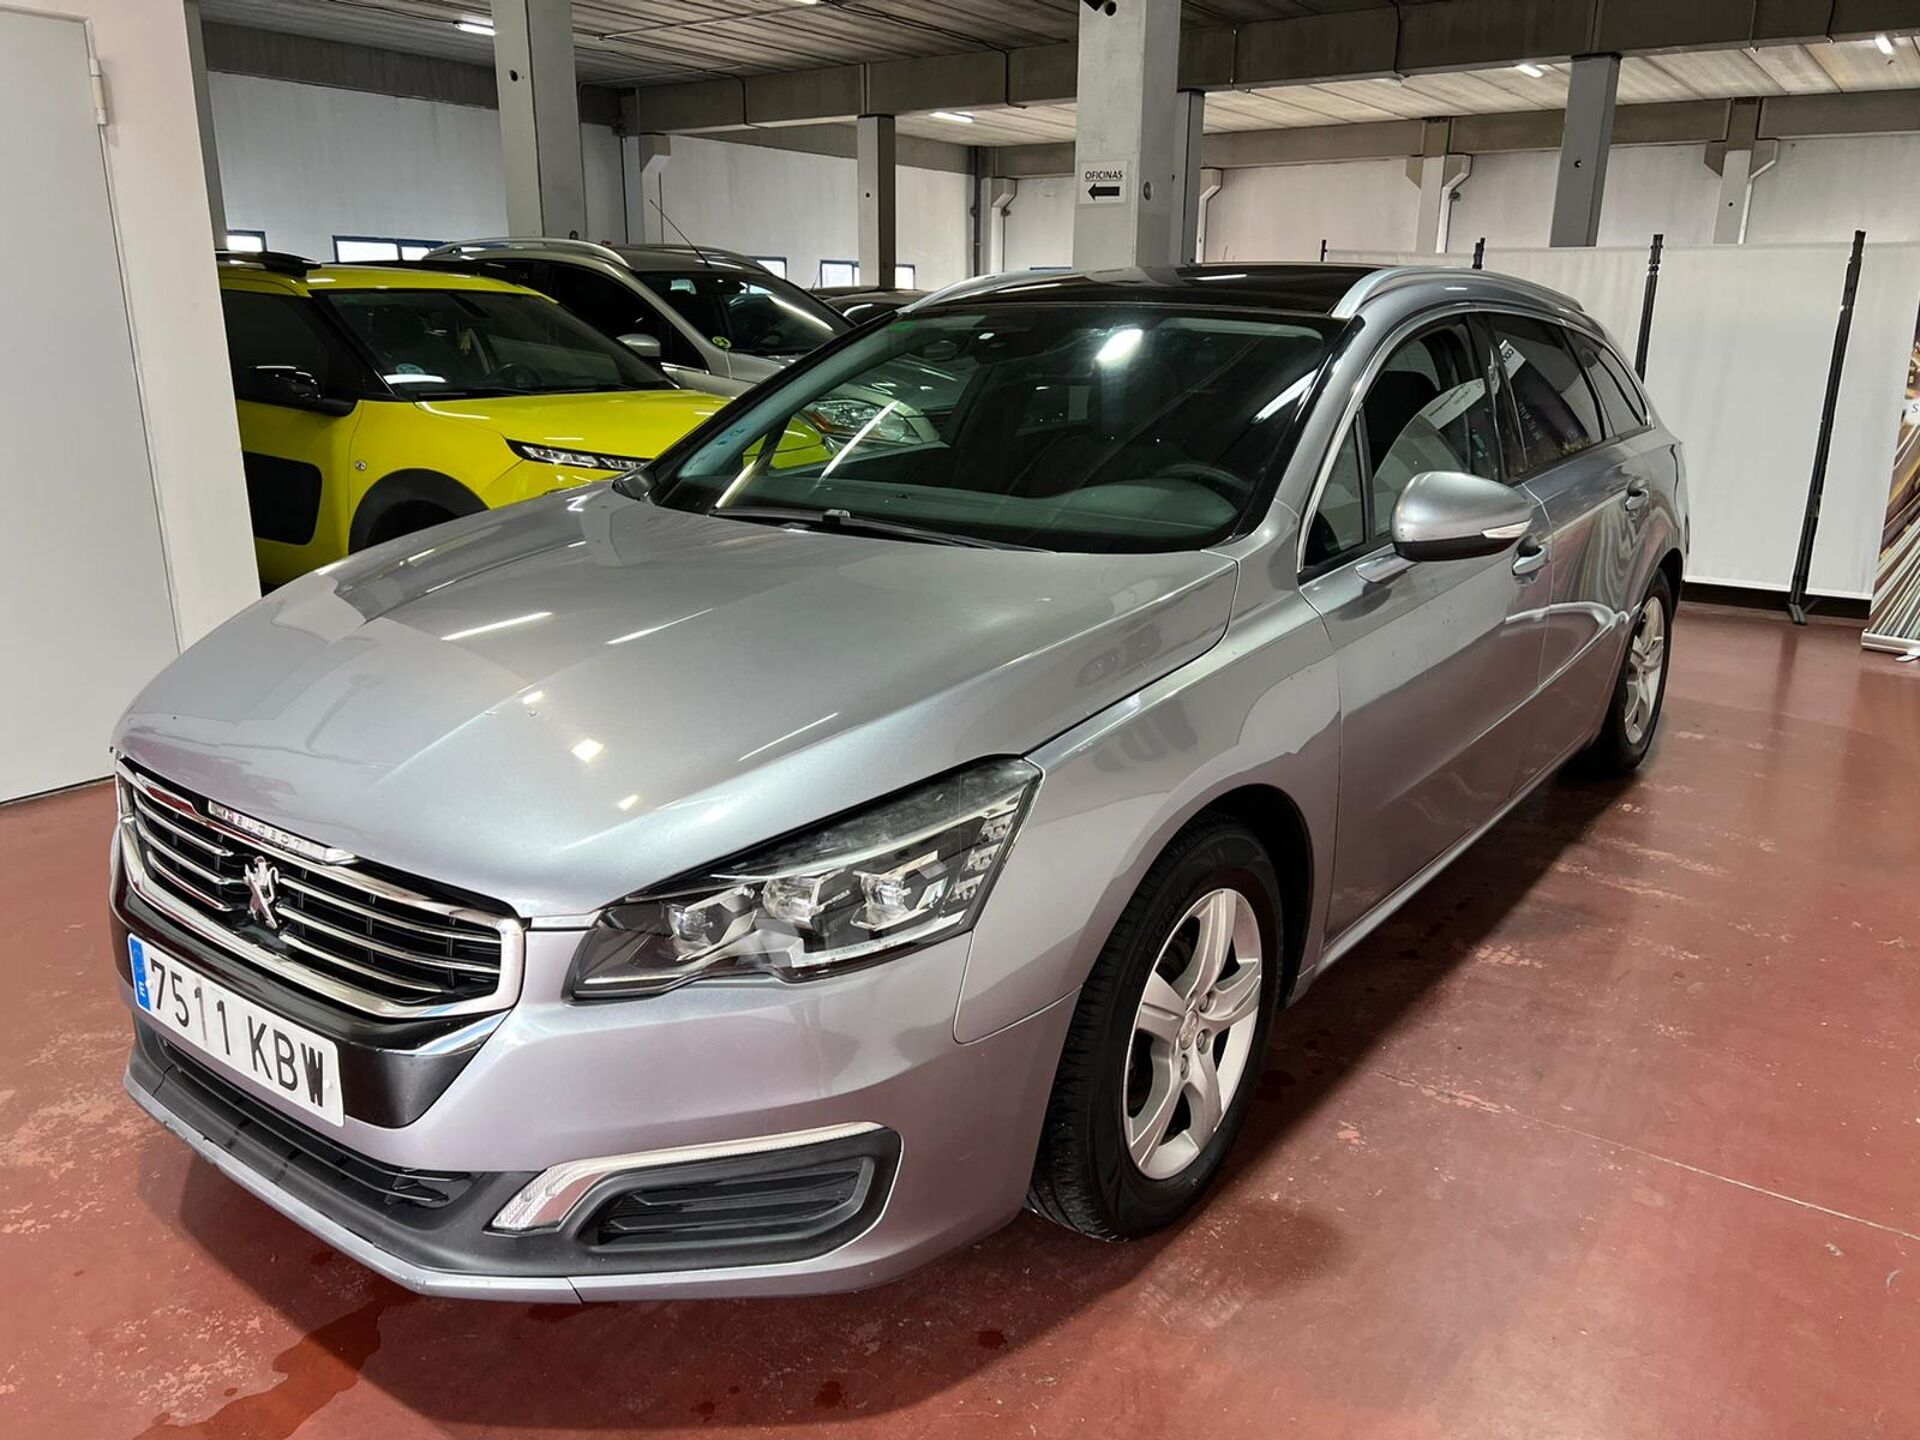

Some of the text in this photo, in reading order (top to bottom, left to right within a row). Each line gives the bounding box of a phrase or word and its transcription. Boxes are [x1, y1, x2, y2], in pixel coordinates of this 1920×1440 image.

[1085, 170, 1123, 180] OFICINAS
[150, 957, 324, 1108] 7511 KBW
